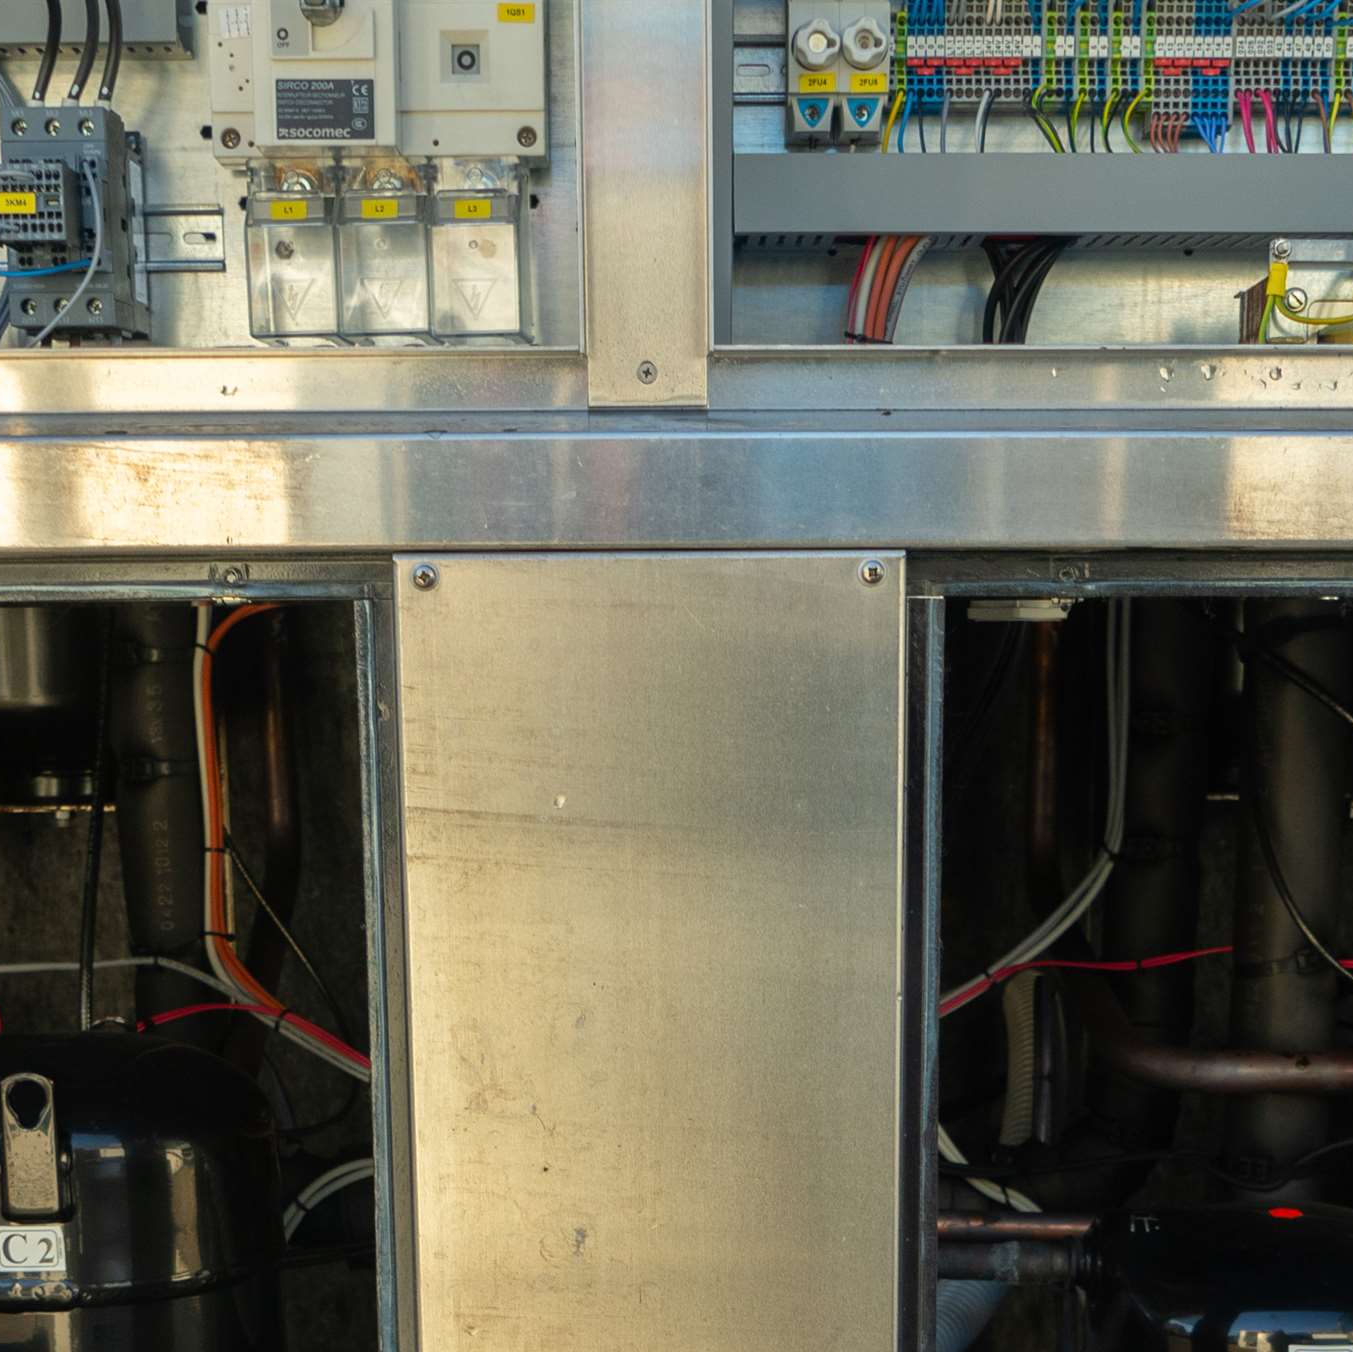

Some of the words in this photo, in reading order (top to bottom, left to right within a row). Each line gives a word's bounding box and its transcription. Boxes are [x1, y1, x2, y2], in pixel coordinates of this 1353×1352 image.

[277, 81, 309, 90] SIRCO
[311, 81, 334, 90] 200A
[289, 127, 351, 138] socomec
[283, 206, 294, 214] L1
[375, 204, 385, 213] L2
[467, 204, 478, 213] L3
